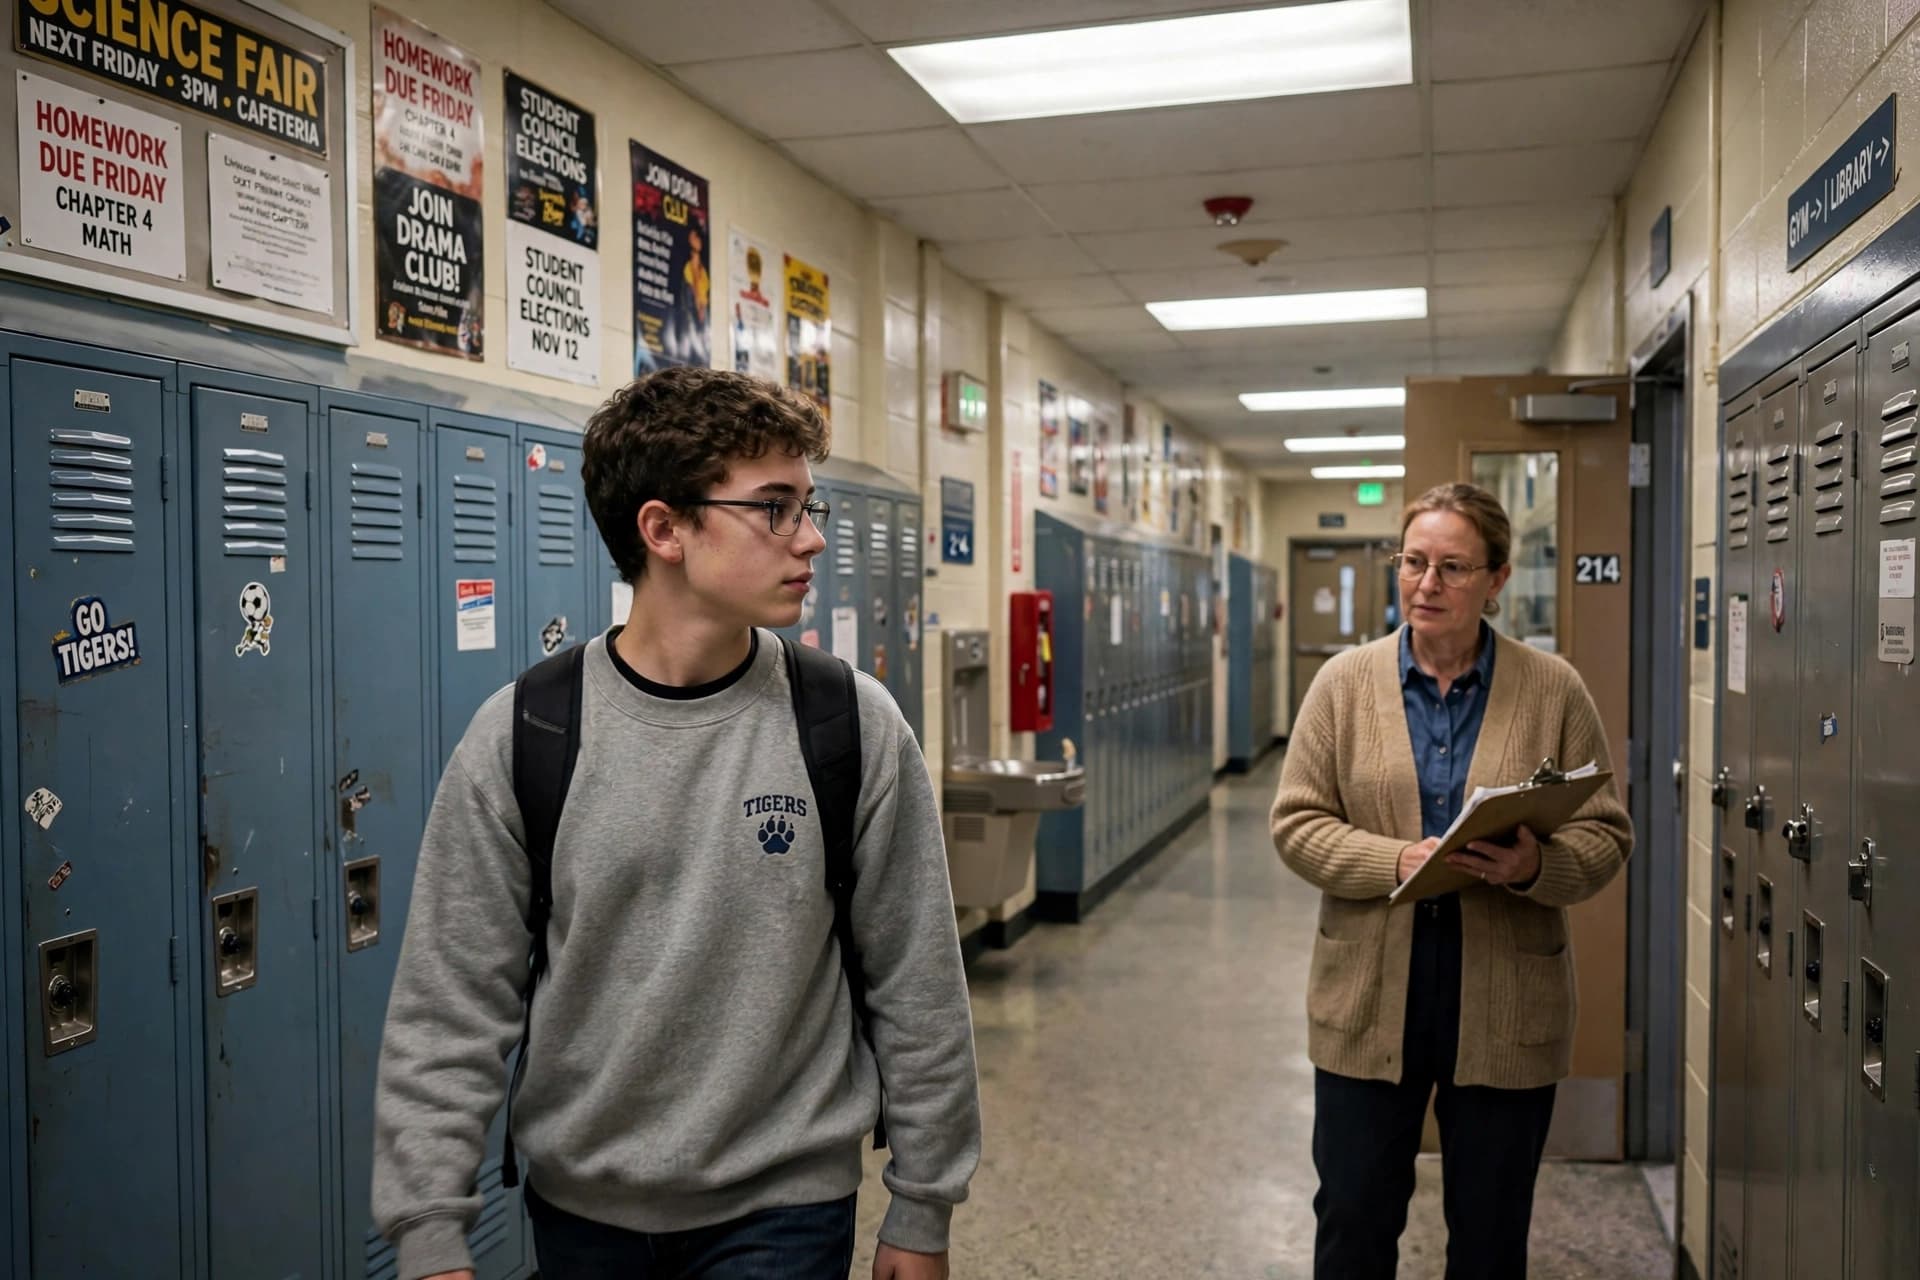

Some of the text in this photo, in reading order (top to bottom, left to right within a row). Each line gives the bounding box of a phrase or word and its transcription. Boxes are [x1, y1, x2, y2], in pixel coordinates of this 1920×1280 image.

[30, 16, 320, 148] NEXT FRIDAY 3PM CAFETERIA
[236, 34, 319, 118] FAIR
[383, 28, 474, 98] HOMEWORK
[384, 65, 474, 130] DUE FRIDAY
[520, 87, 580, 133] STUDENT
[36, 99, 169, 170] HOMEWORK
[521, 113, 580, 158] COUNCIL
[39, 141, 167, 205] DUE FRIDAY
[515, 134, 587, 185] ELECTIONS
[56, 185, 153, 232] CHAPTER 4
[408, 187, 454, 227] JOIN
[1789, 140, 1874, 249] GYM LIBRARY
[82, 222, 132, 257] MATH
[396, 214, 467, 265] DRAMA
[404, 252, 461, 293] CLUB!
[525, 246, 584, 285] STUDENT
[526, 274, 584, 311] COUNCIL
[520, 298, 590, 339] ELECTIONS
[532, 328, 579, 361] NOV 12
[1576, 556, 1620, 582] 214
[76, 601, 105, 636] GO
[58, 626, 136, 676] TIGERS!
[743, 795, 807, 818] TIGERS
